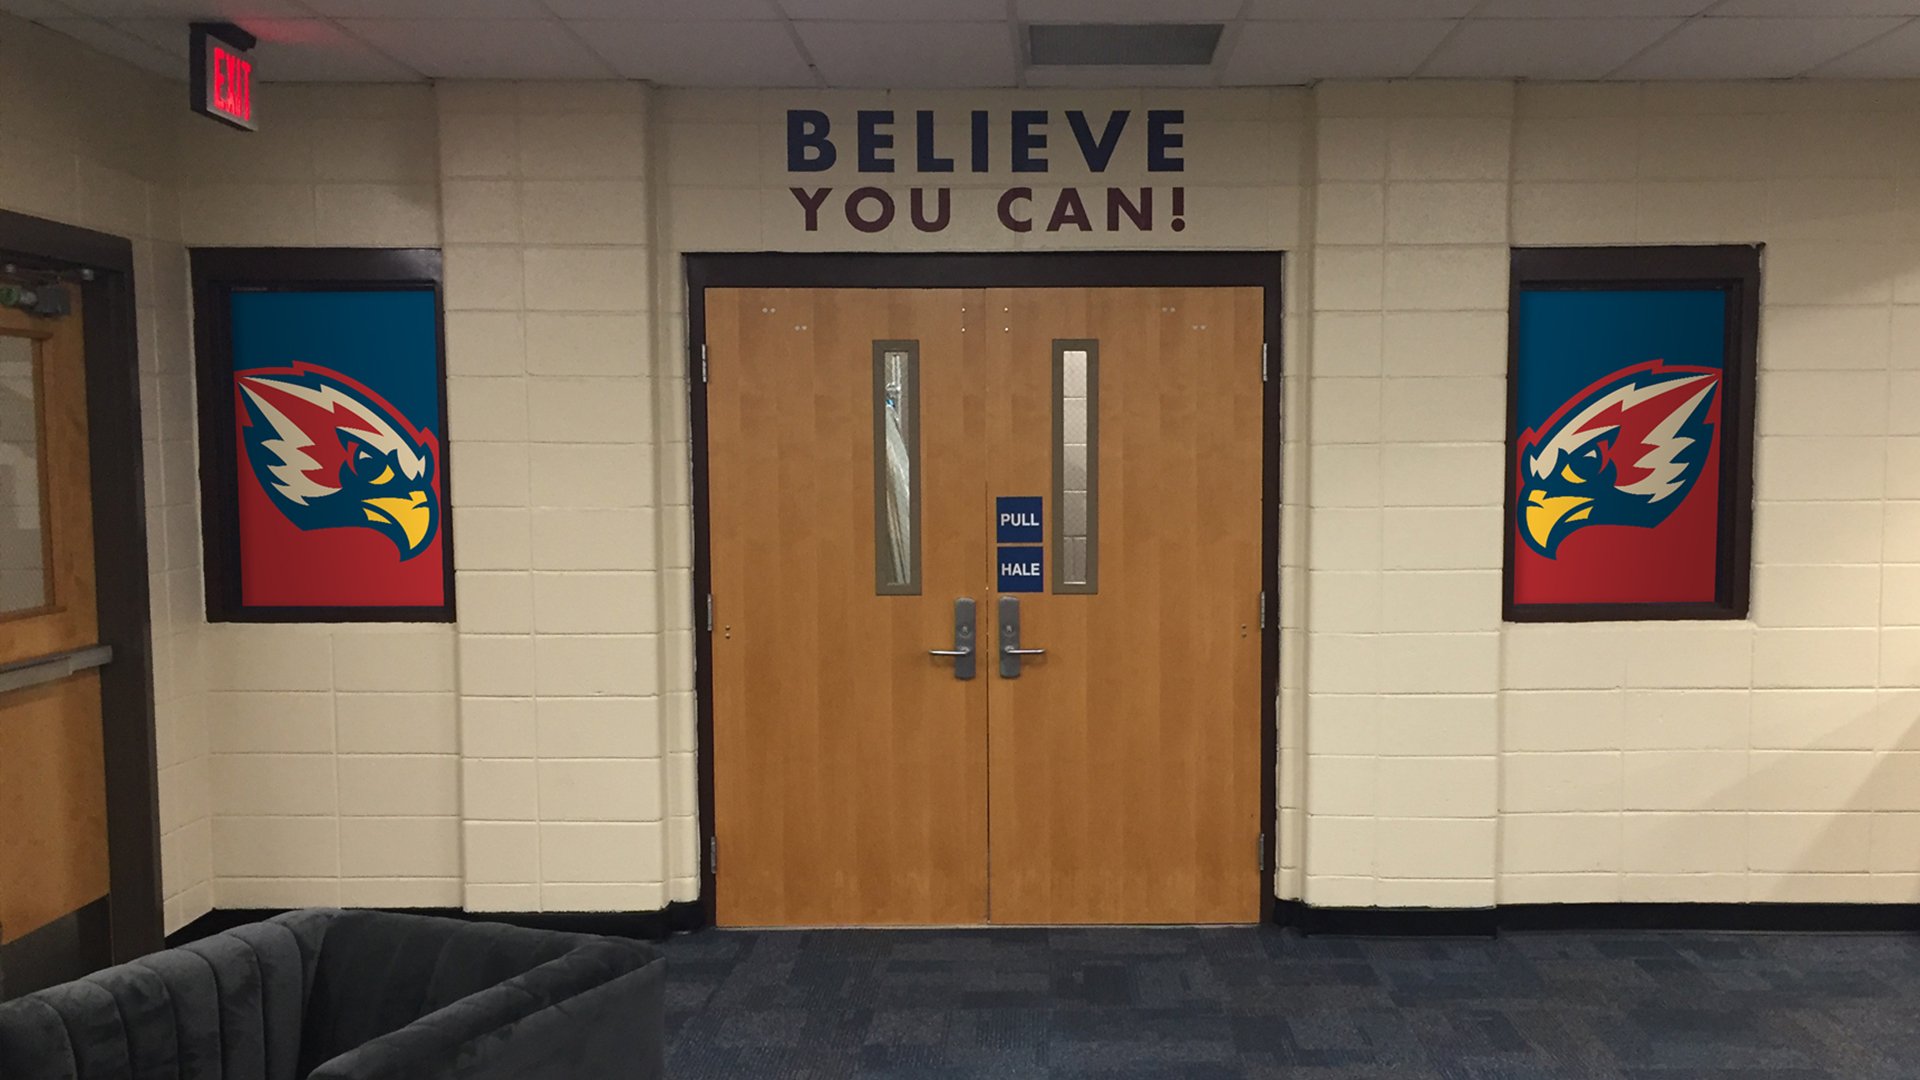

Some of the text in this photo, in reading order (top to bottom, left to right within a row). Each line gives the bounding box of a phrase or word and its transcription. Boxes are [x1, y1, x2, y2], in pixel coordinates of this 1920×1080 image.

[213, 47, 252, 121] EXIT
[787, 110, 1185, 173] BELIEVE
[789, 186, 1186, 233] YOU CAN!
[1000, 513, 1039, 527] PULL
[1001, 563, 1040, 576] HALE
